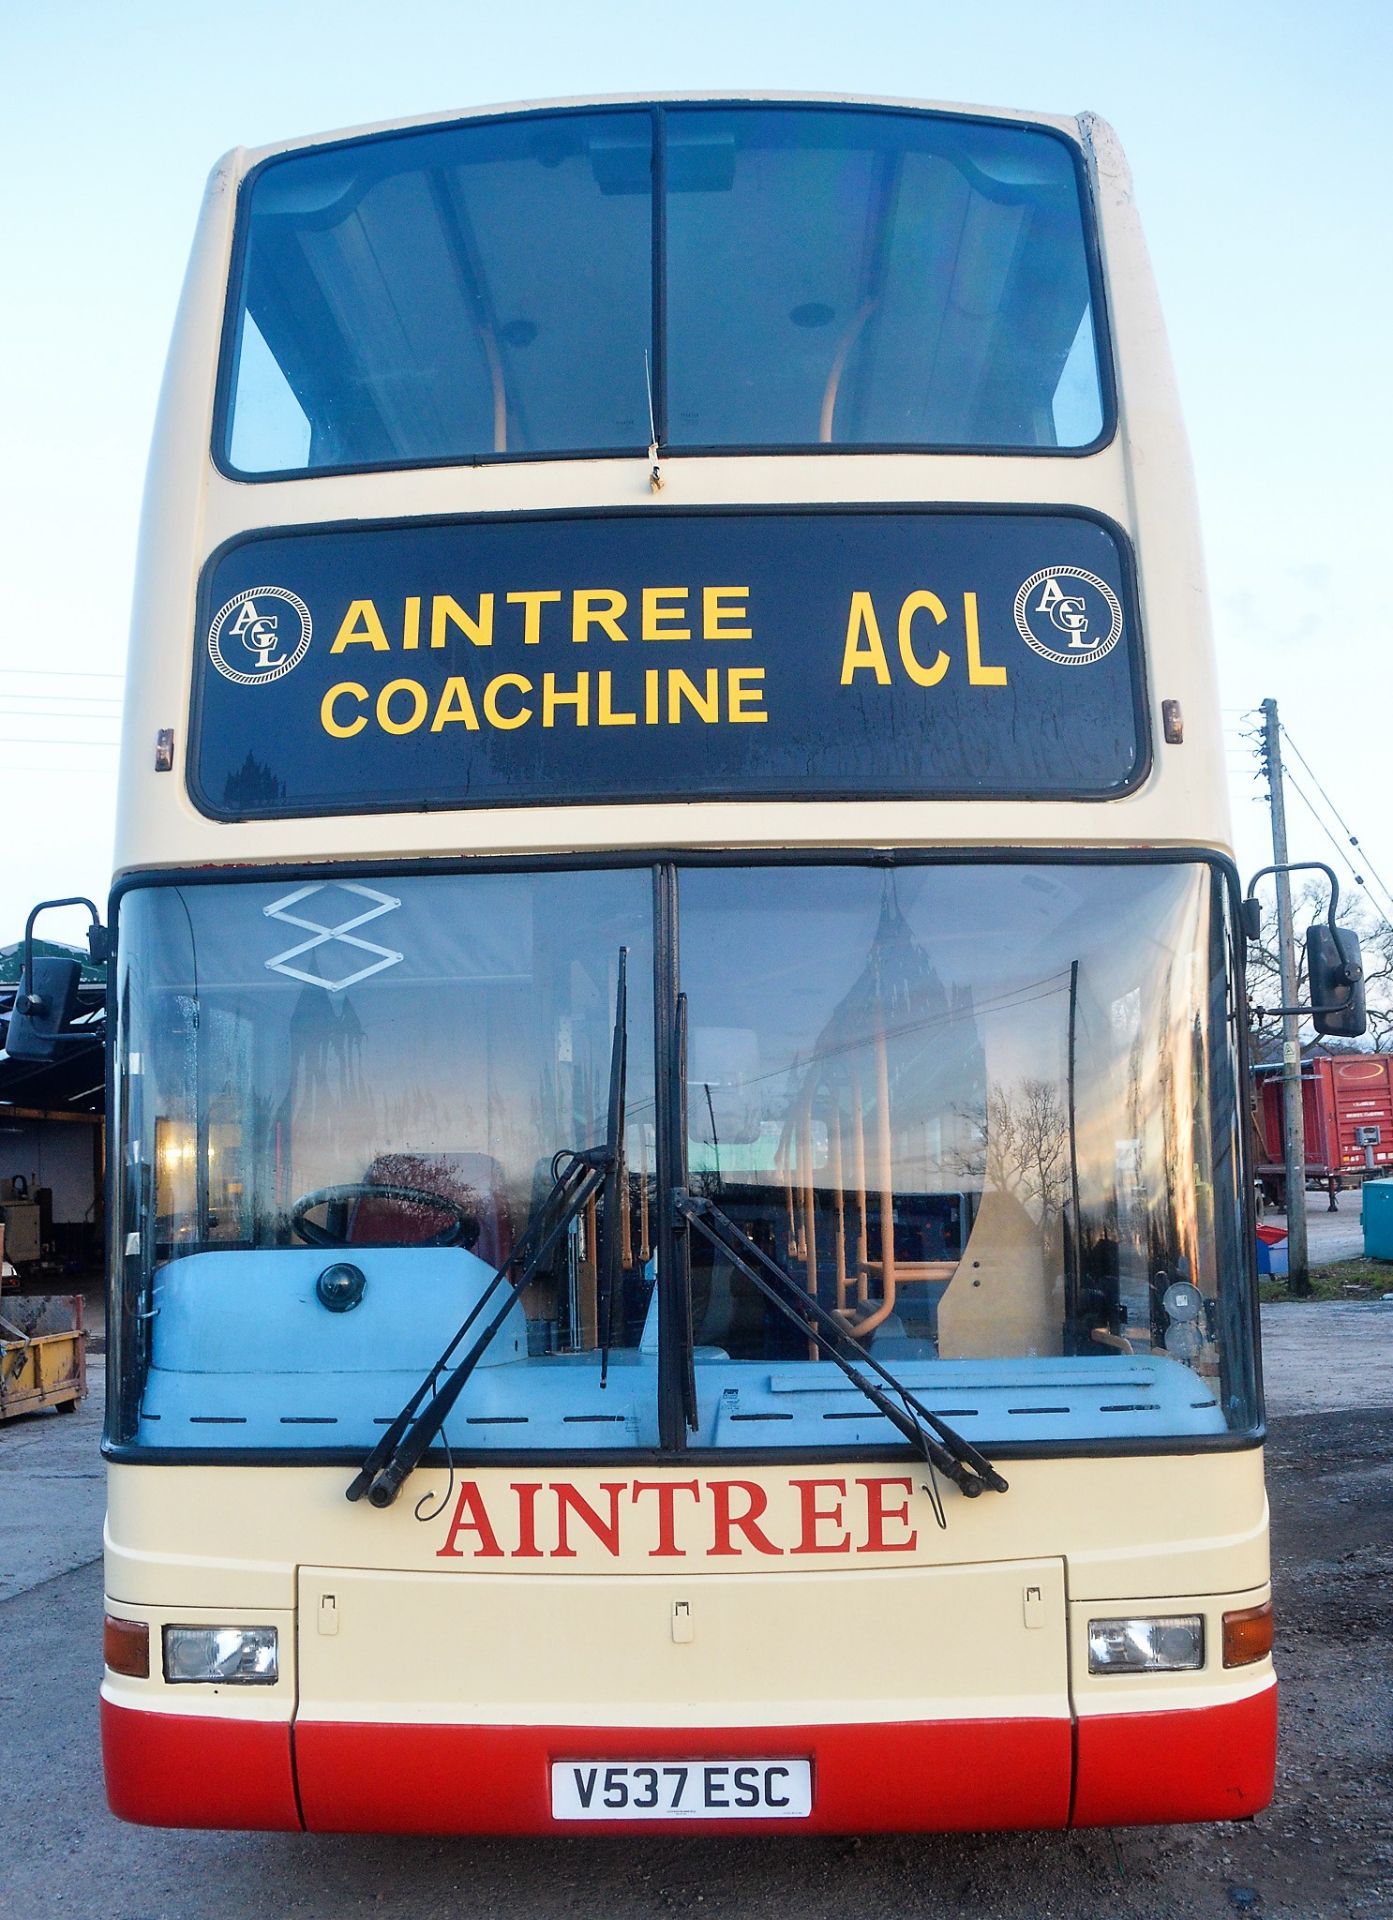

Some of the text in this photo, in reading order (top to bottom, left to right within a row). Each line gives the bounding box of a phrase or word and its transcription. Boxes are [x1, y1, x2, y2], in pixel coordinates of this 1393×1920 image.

[330, 586, 753, 654] AINTREE
[840, 590, 1008, 687] ACL
[320, 667, 768, 739] COACHLINE
[436, 1477, 918, 1557] AINTREE
[573, 1767, 790, 1808] V537 ESC
